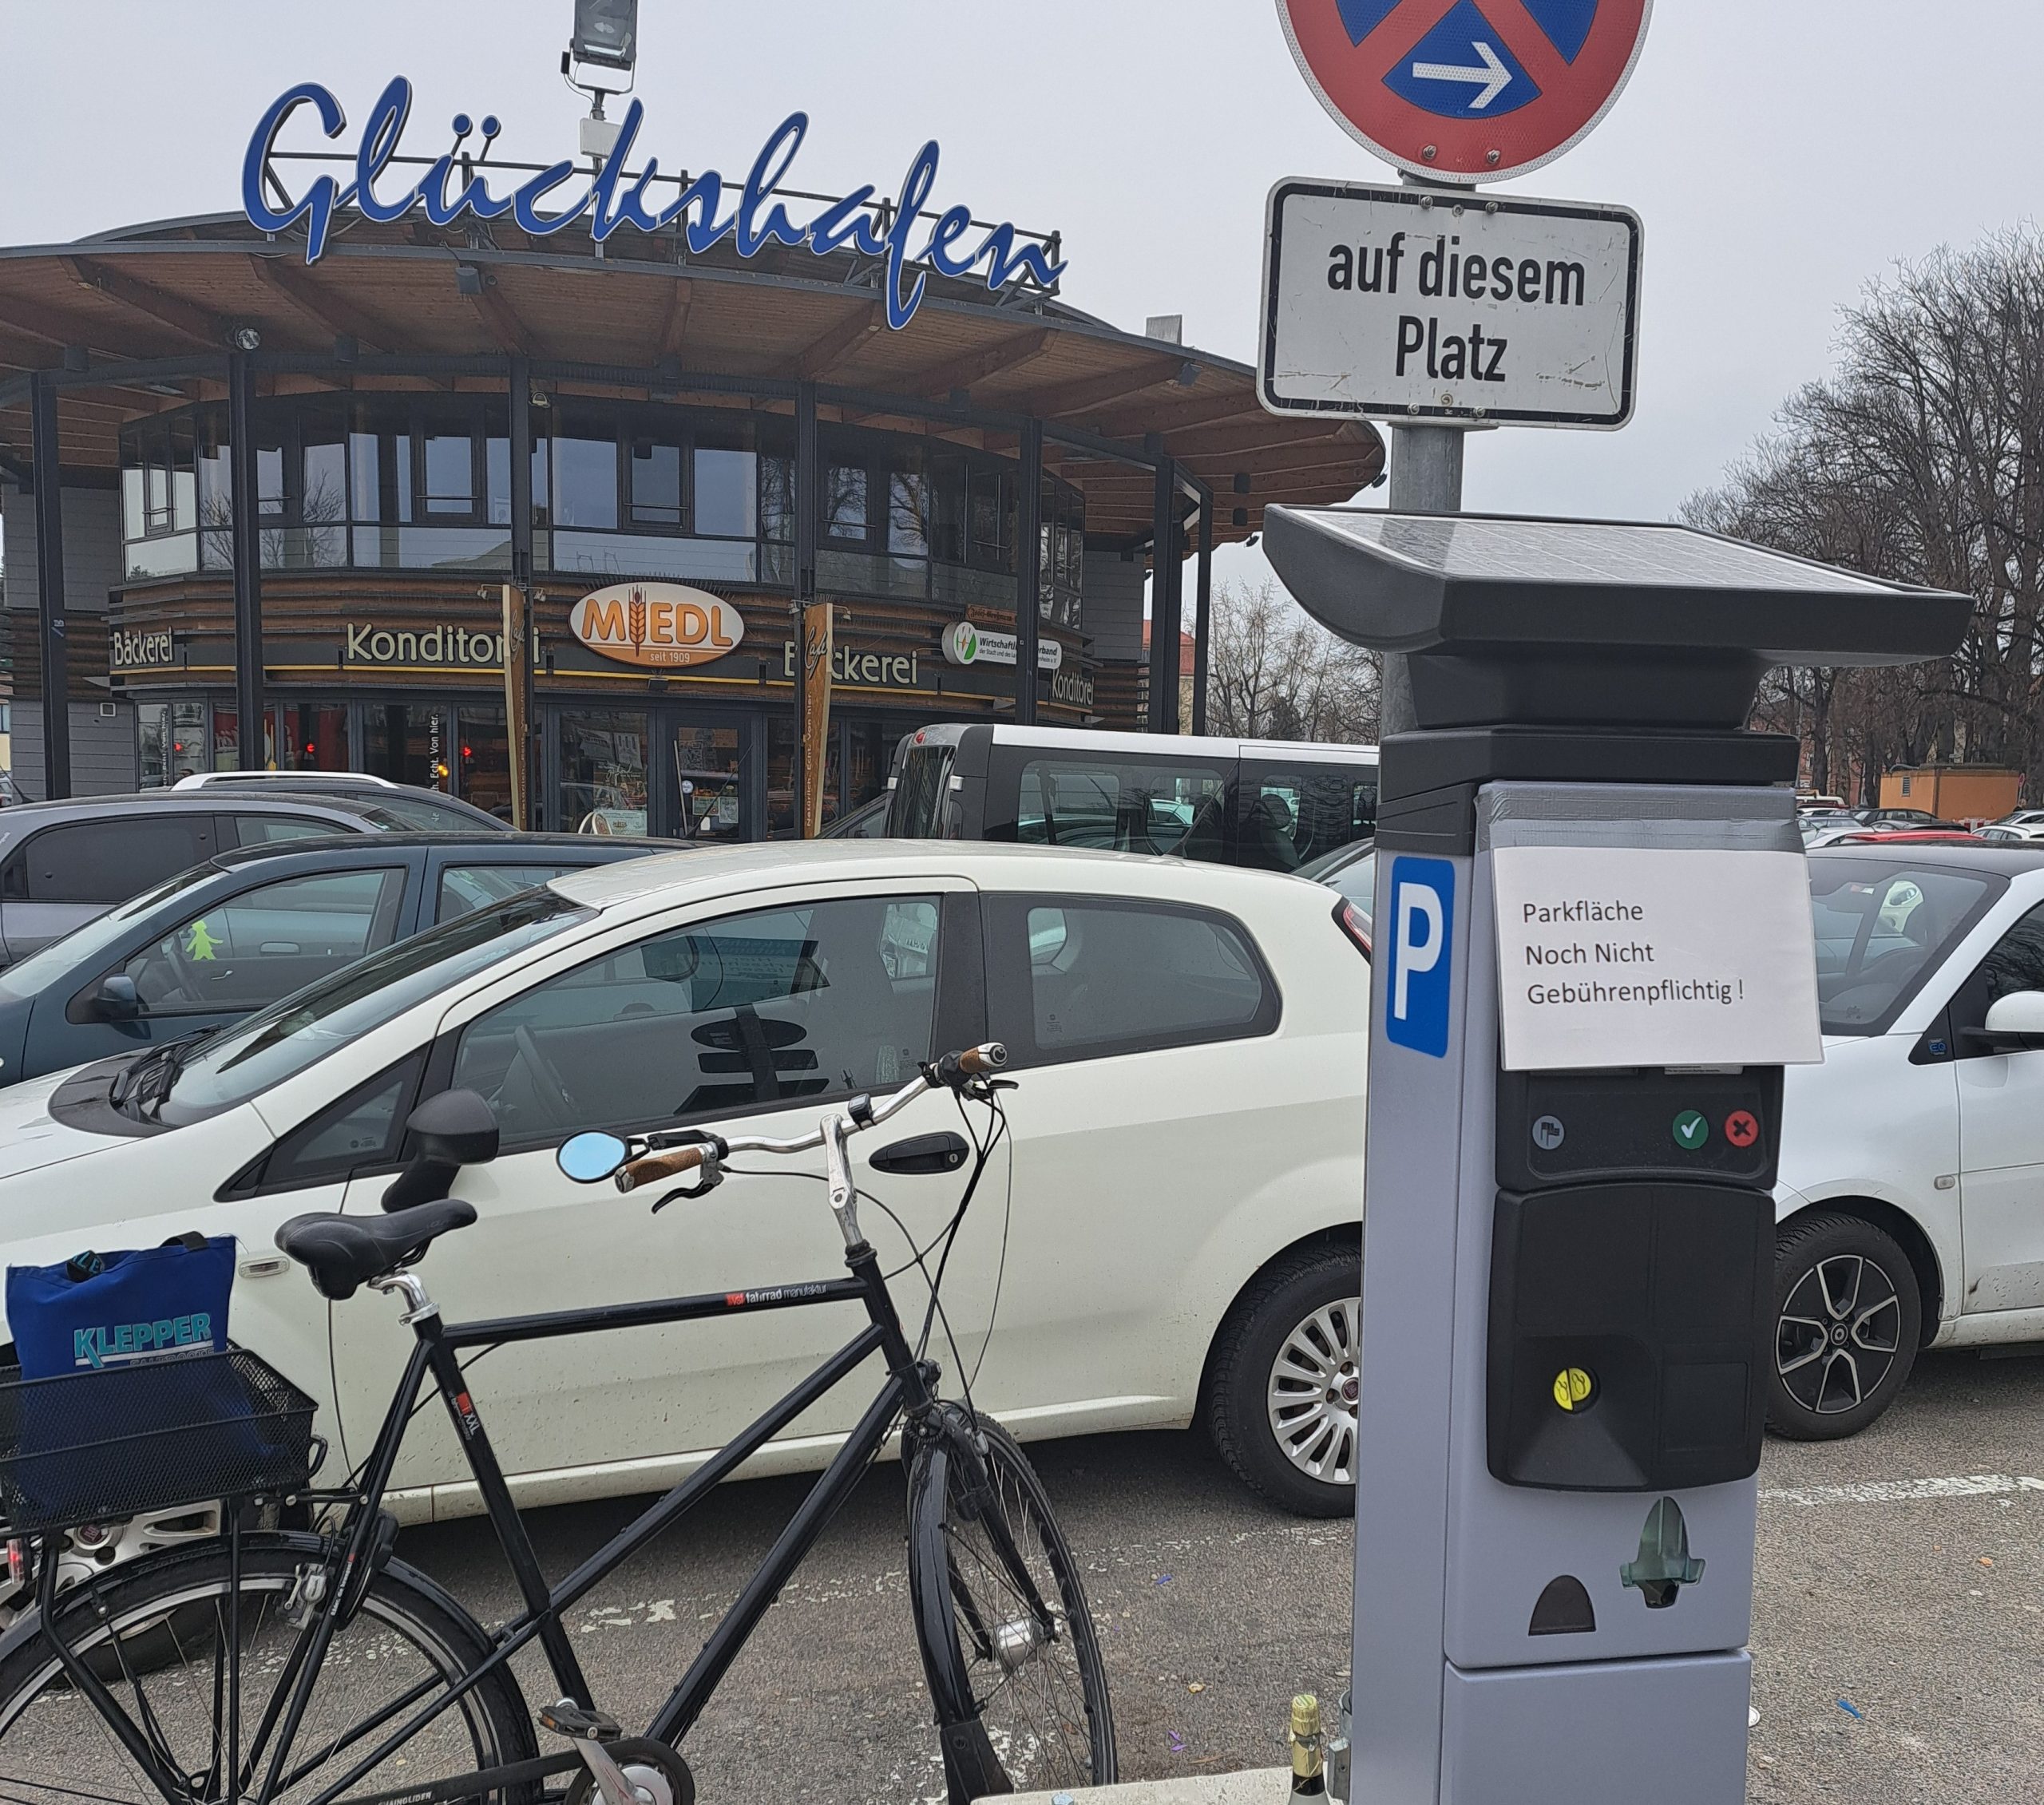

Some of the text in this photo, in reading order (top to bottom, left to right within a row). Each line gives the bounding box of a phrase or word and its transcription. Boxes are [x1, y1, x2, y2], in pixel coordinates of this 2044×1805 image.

[242, 75, 1068, 330] Glückshafen
[1327, 232, 1585, 306] auf diesem
[1395, 315, 1507, 382] Platz
[114, 626, 172, 667] Bäckerei
[347, 623, 540, 664] Konditori
[650, 651, 690, 663] seit 1909
[784, 641, 917, 684] Bckerei
[980, 637, 1058, 655] Wirtschaftl rband
[1052, 669, 1094, 706] Konditorei
[430, 714, 439, 734] hier.
[430, 736, 439, 754] Von
[1523, 901, 1643, 924] Parkfläche
[1394, 881, 1444, 1021] P
[1525, 942, 1655, 965] Noch Nicht
[1527, 979, 1733, 1005] Gebührenpflichtig
[73, 1312, 212, 1369] KLEPPER
